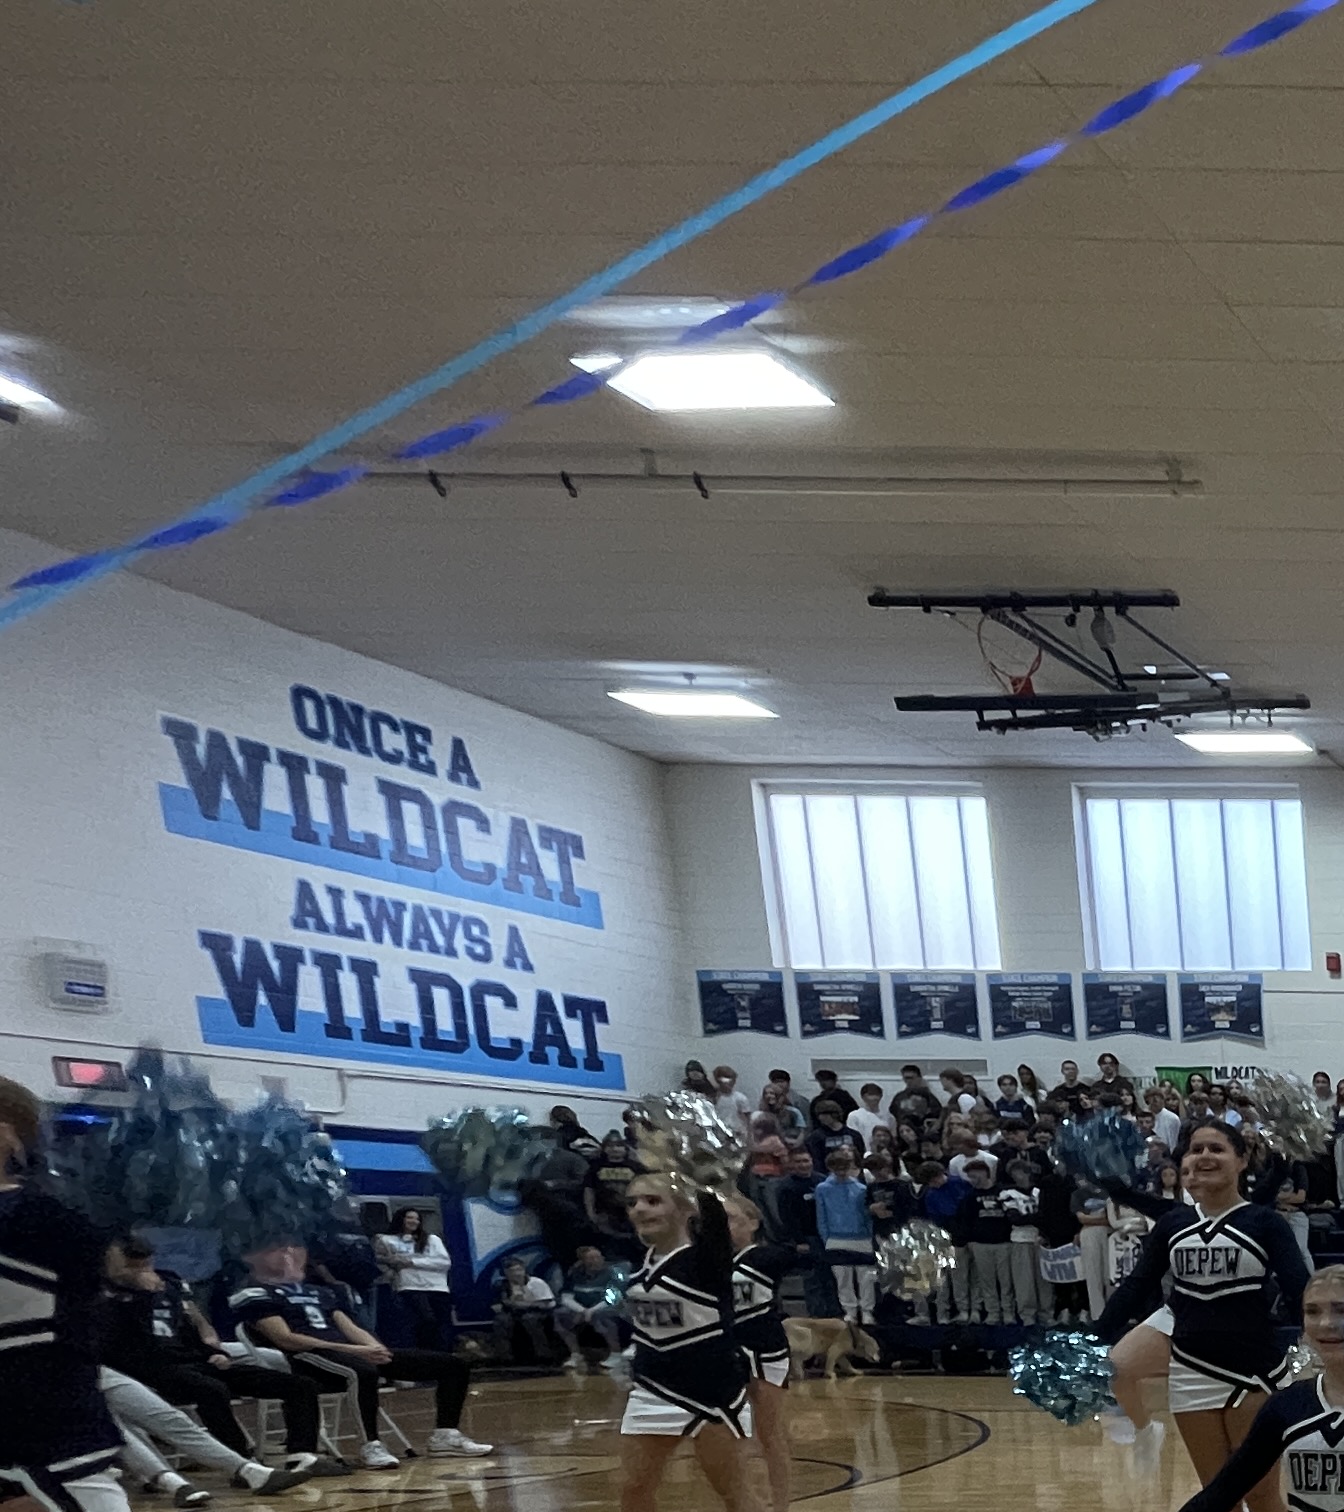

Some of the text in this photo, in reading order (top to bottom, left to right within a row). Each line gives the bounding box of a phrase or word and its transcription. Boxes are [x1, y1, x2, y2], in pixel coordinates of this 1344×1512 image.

[290, 683, 481, 790] ONCE A
[161, 716, 586, 907] WILDCAT
[291, 878, 534, 973] ALWAYS A
[199, 930, 609, 1072] WILDCAT
[1173, 1246, 1242, 1278] DEPEW
